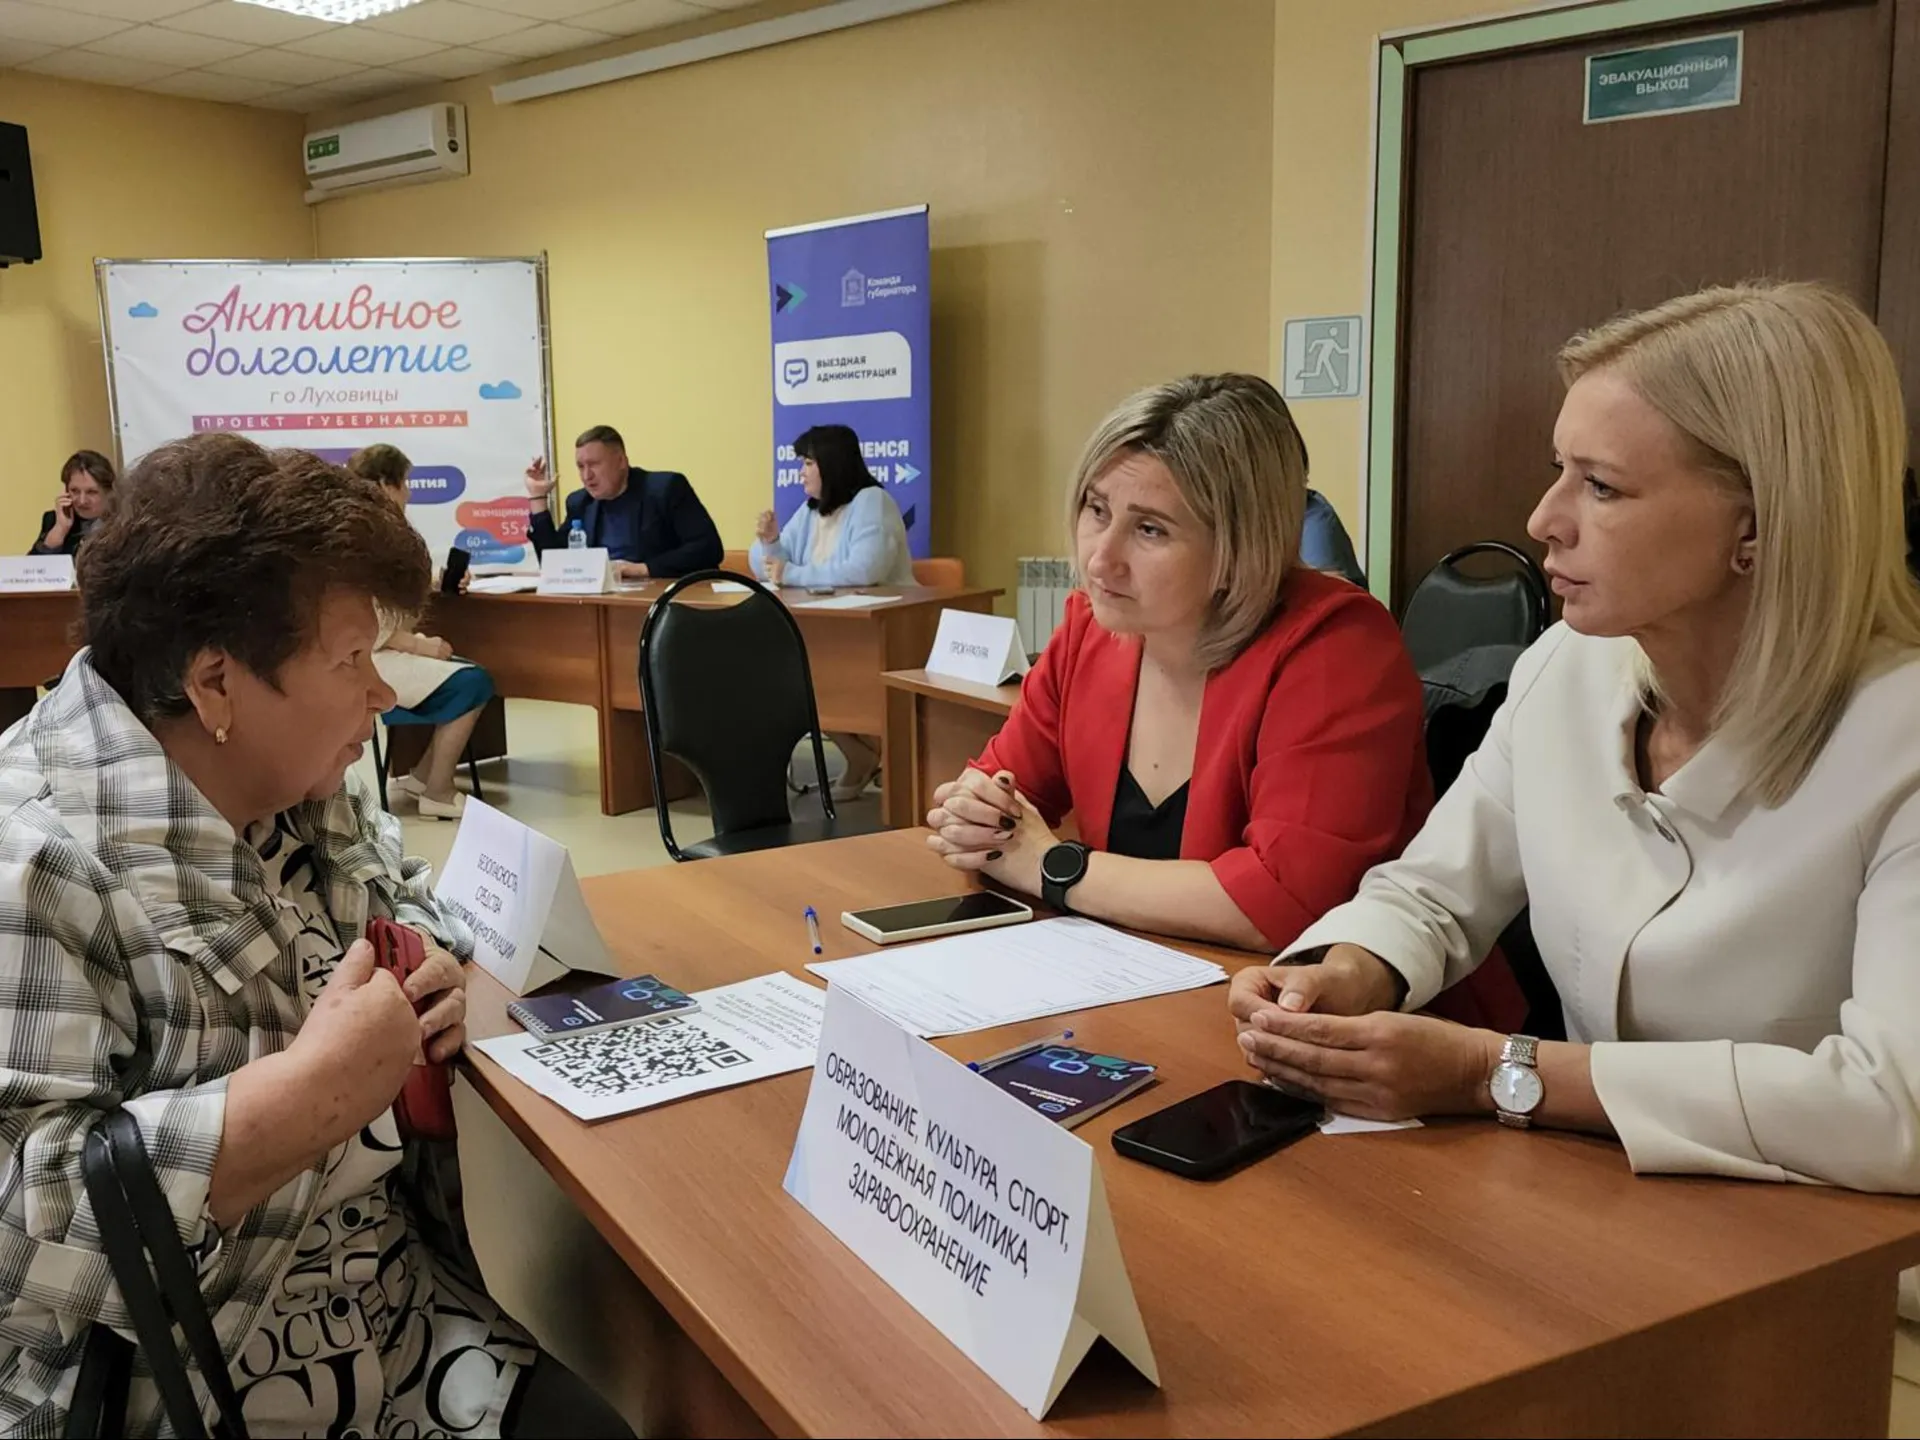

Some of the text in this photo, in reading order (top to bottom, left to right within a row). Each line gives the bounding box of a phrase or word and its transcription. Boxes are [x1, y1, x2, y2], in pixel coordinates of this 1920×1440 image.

[1598, 55, 1729, 86] ЭВАКУАЦИОННЫЙ
[1636, 77, 1689, 95] ВЫХОД
[182, 284, 461, 333] Активное
[186, 328, 472, 376] долголетие
[816, 355, 867, 368] ВЫЕЗДНАЯ
[816, 367, 897, 382] АДМИНИСТРАЦИЯ
[302, 387, 399, 407] Луховицы
[201, 412, 463, 429] ПРОЕКТ ГУБЕРНАТОРА
[826, 1052, 1070, 1253] ОБРАЗОВАНИЕ, КУЛЬТУРА, СПОРТ,
[836, 1104, 1029, 1278] МОЛОДЁЖНАЯ ПОЛИТИКА,
[848, 1162, 992, 1297] ЗДРАВООХРАНЕНИЕ
